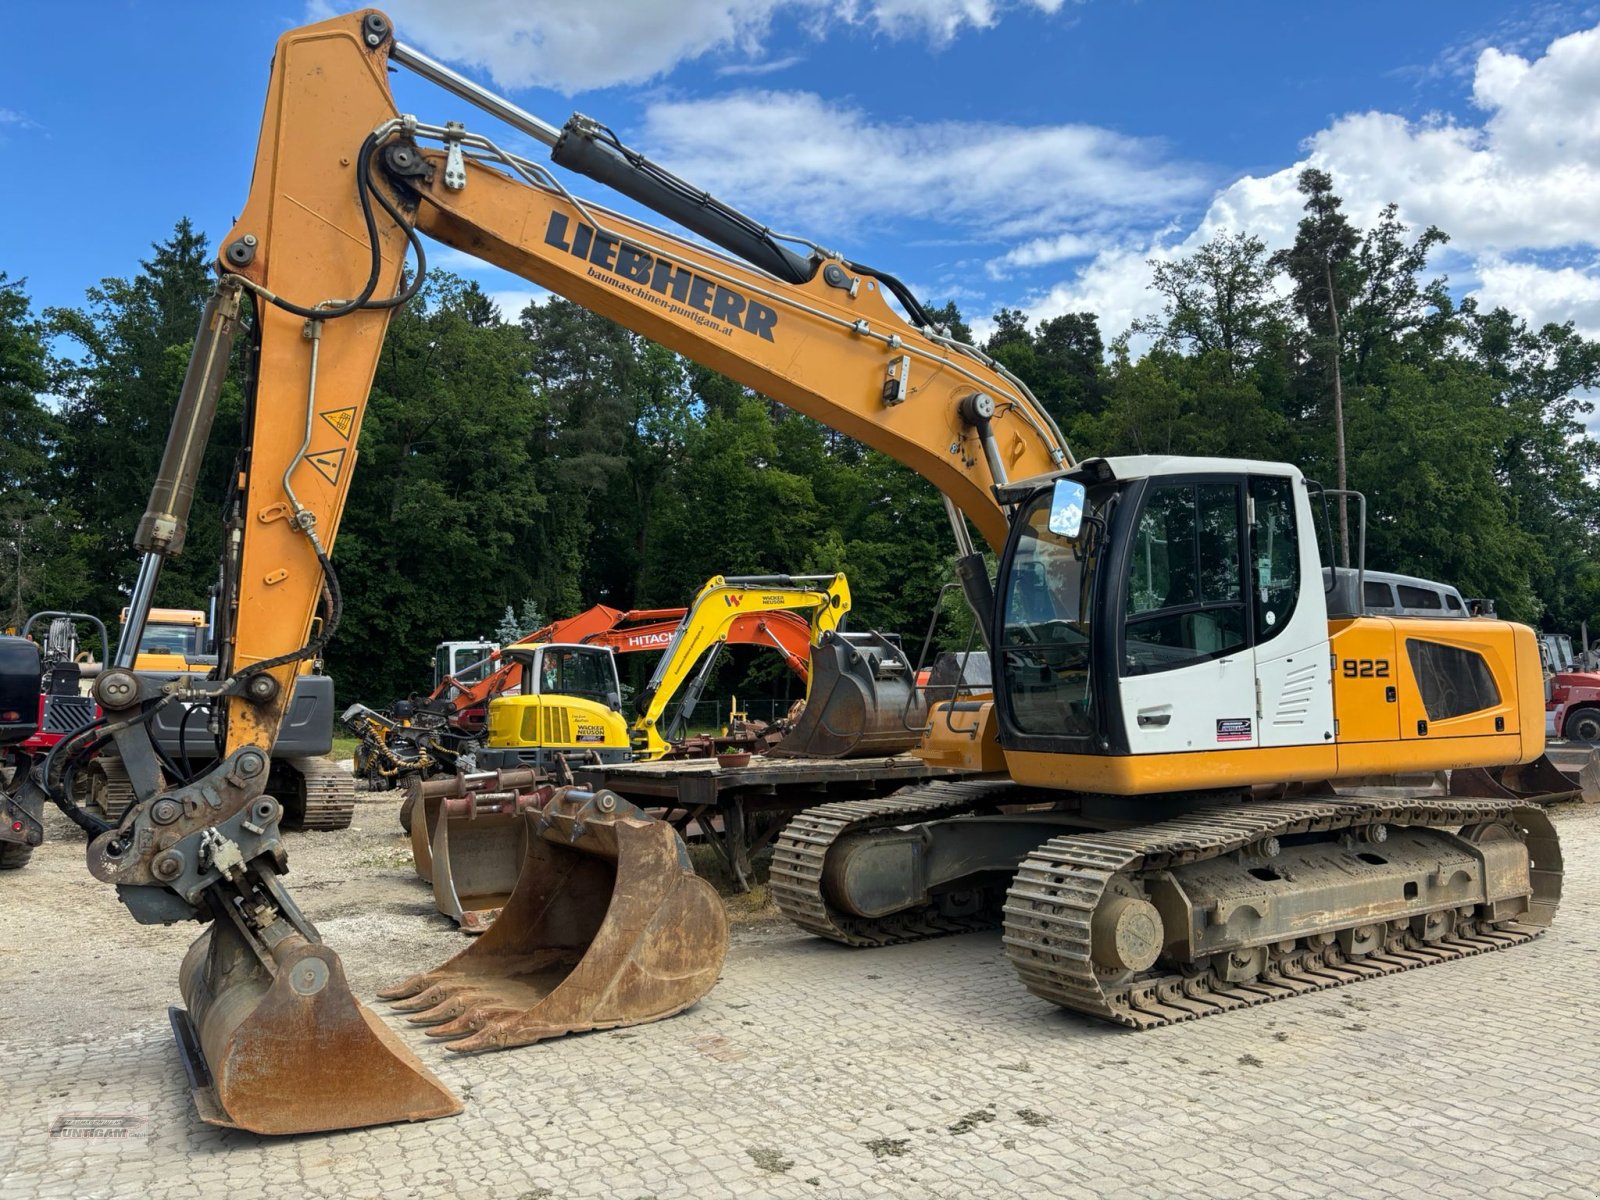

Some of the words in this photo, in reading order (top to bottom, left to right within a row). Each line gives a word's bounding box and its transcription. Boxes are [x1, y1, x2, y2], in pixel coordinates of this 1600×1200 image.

[544, 210, 778, 343] LIEBHERR
[586, 266, 733, 337] baumaschinen-puntigam.at
[629, 632, 678, 647] HITACH
[1343, 659, 1390, 678] 922
